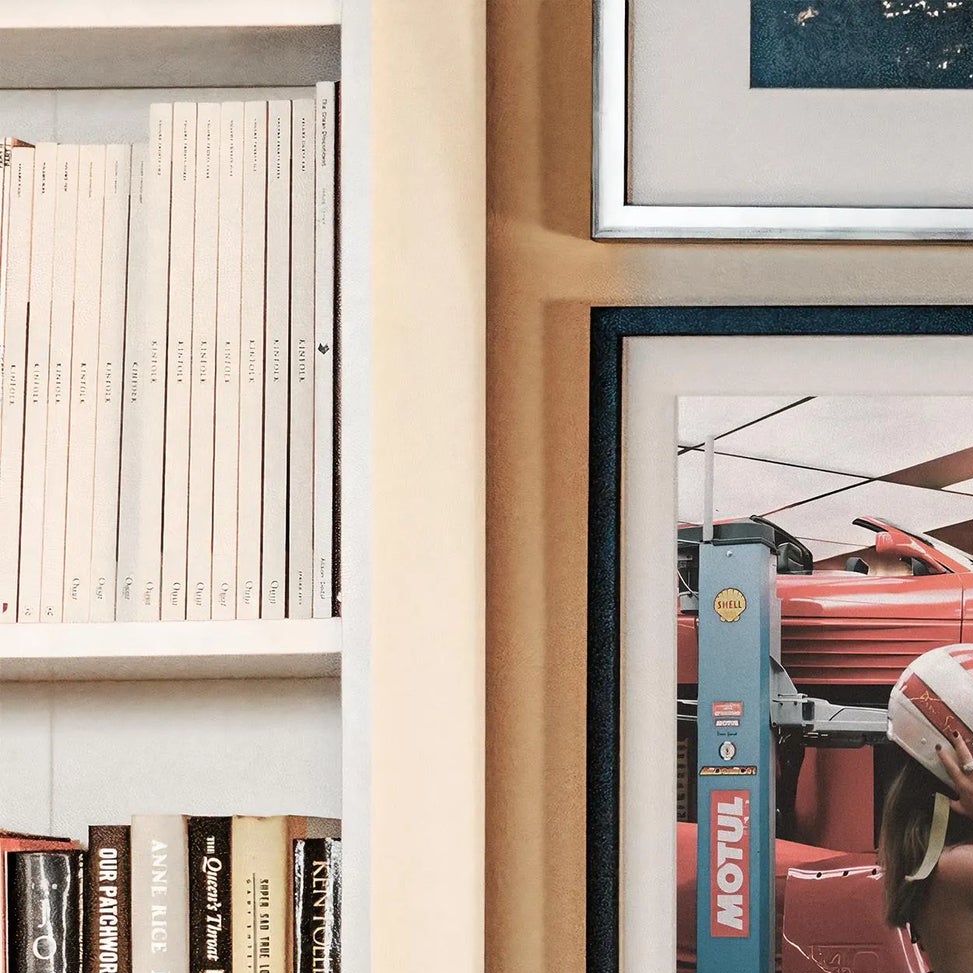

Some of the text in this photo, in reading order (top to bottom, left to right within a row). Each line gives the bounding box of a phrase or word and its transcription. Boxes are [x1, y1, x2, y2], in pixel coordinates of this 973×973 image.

[717, 600, 742, 609] SHELL
[99, 848, 118, 881] OUR
[717, 796, 744, 930] MOTUL
[151, 840, 168, 953] ANNE RICE
[202, 856, 222, 911] Queen's
[260, 879, 270, 907] SUPER
[312, 860, 331, 908] KEN
[206, 914, 222, 961] Throat
[260, 914, 270, 931] SAD
[260, 936, 270, 959] TRUE
